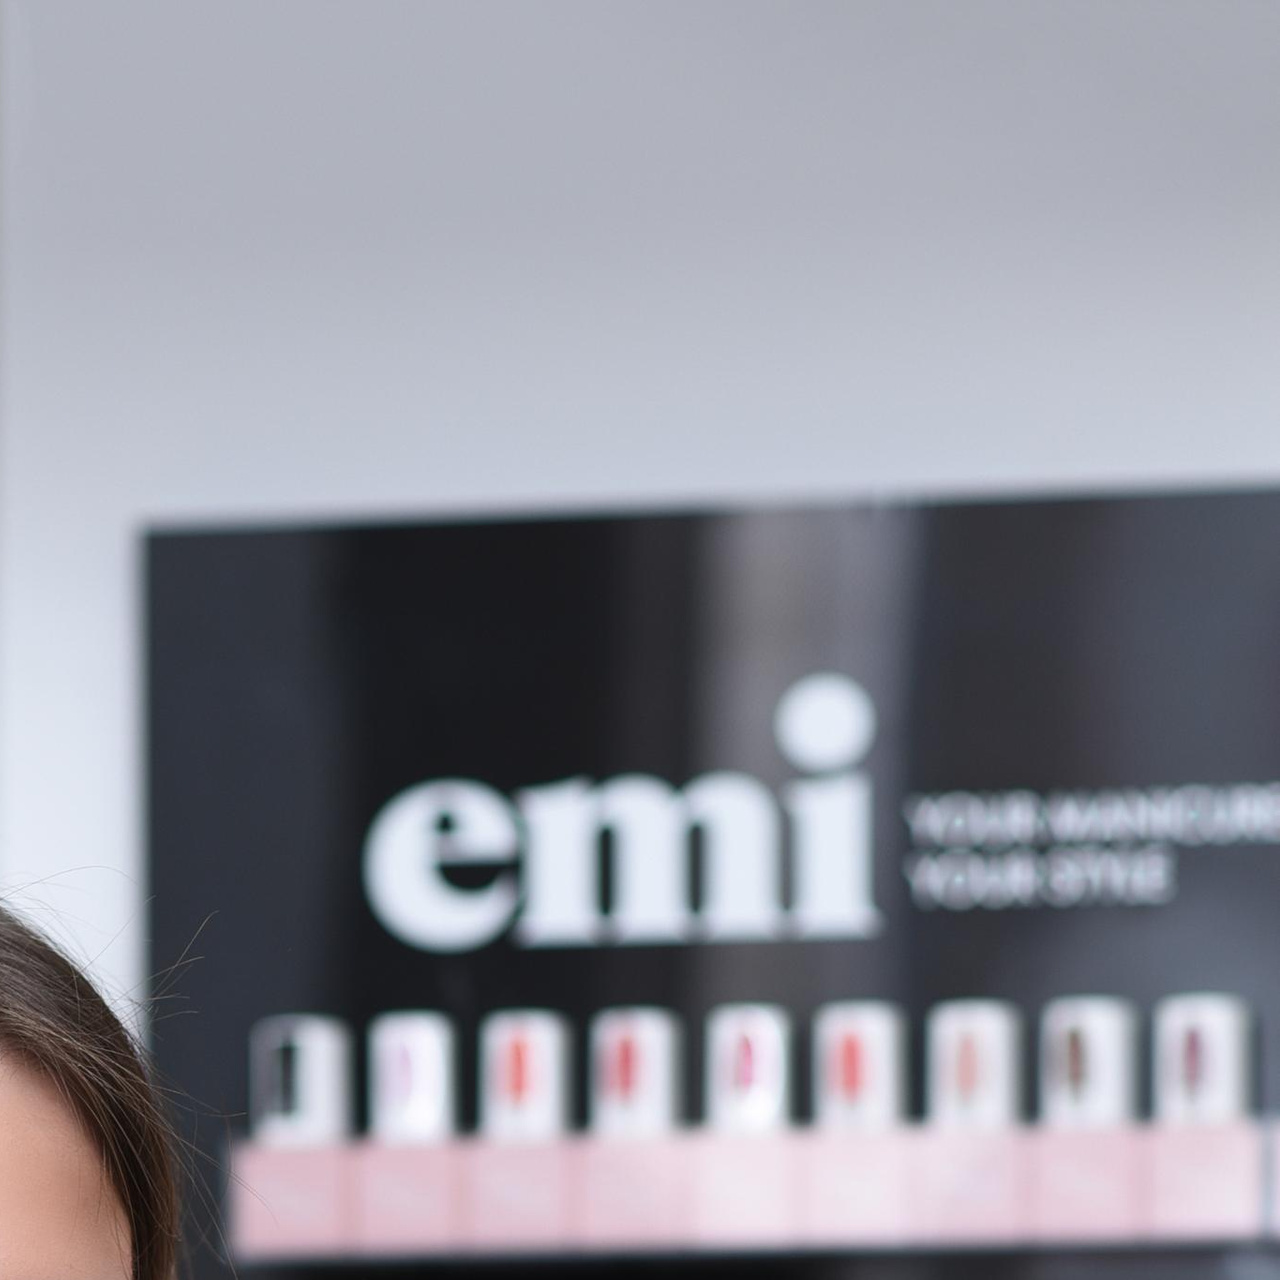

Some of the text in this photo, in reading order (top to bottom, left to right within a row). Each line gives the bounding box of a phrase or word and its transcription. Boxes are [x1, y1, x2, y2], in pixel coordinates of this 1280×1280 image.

[363, 672, 883, 952] emi
[904, 789, 1042, 850] YOUR
[904, 845, 1176, 909] YOUR STYLE
